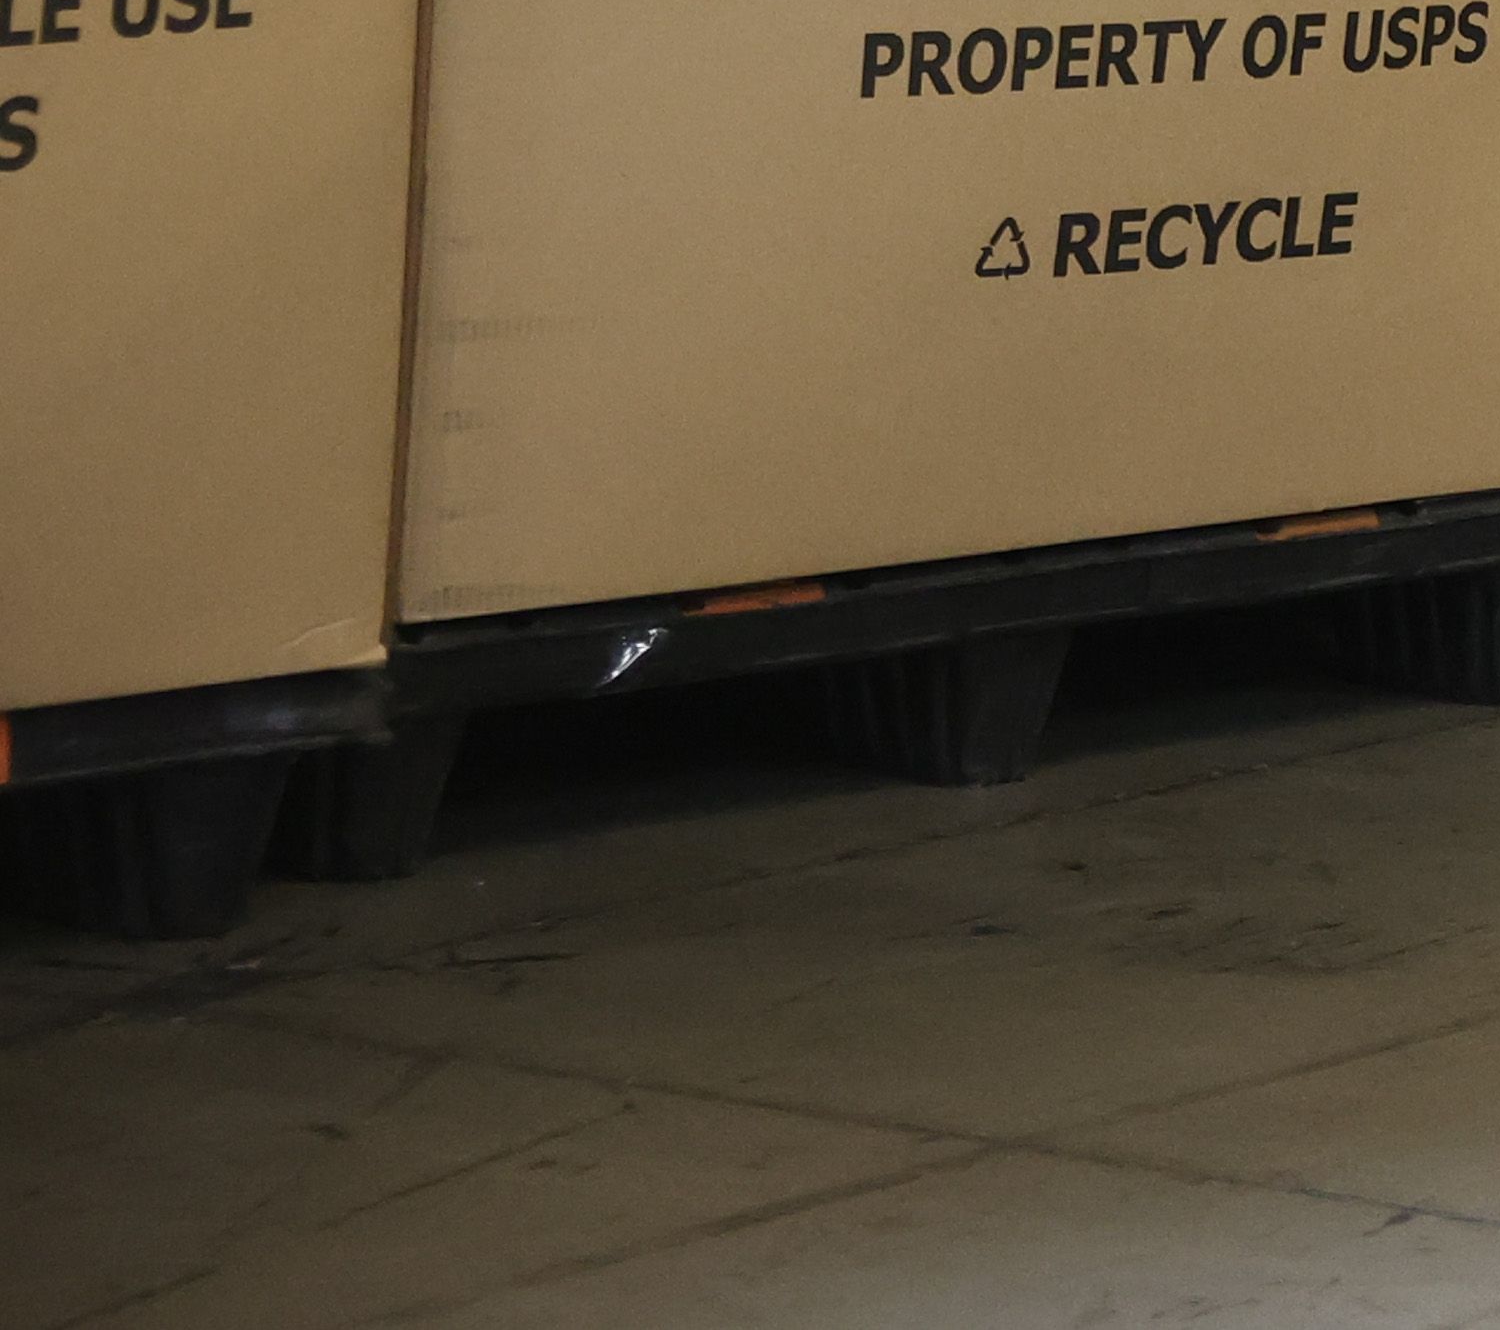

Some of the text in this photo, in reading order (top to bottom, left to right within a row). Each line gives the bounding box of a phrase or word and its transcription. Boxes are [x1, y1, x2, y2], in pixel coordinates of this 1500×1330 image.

[859, 1, 1491, 100] PROPERTY OF USPS
[1053, 191, 1359, 280] RECYCLE
